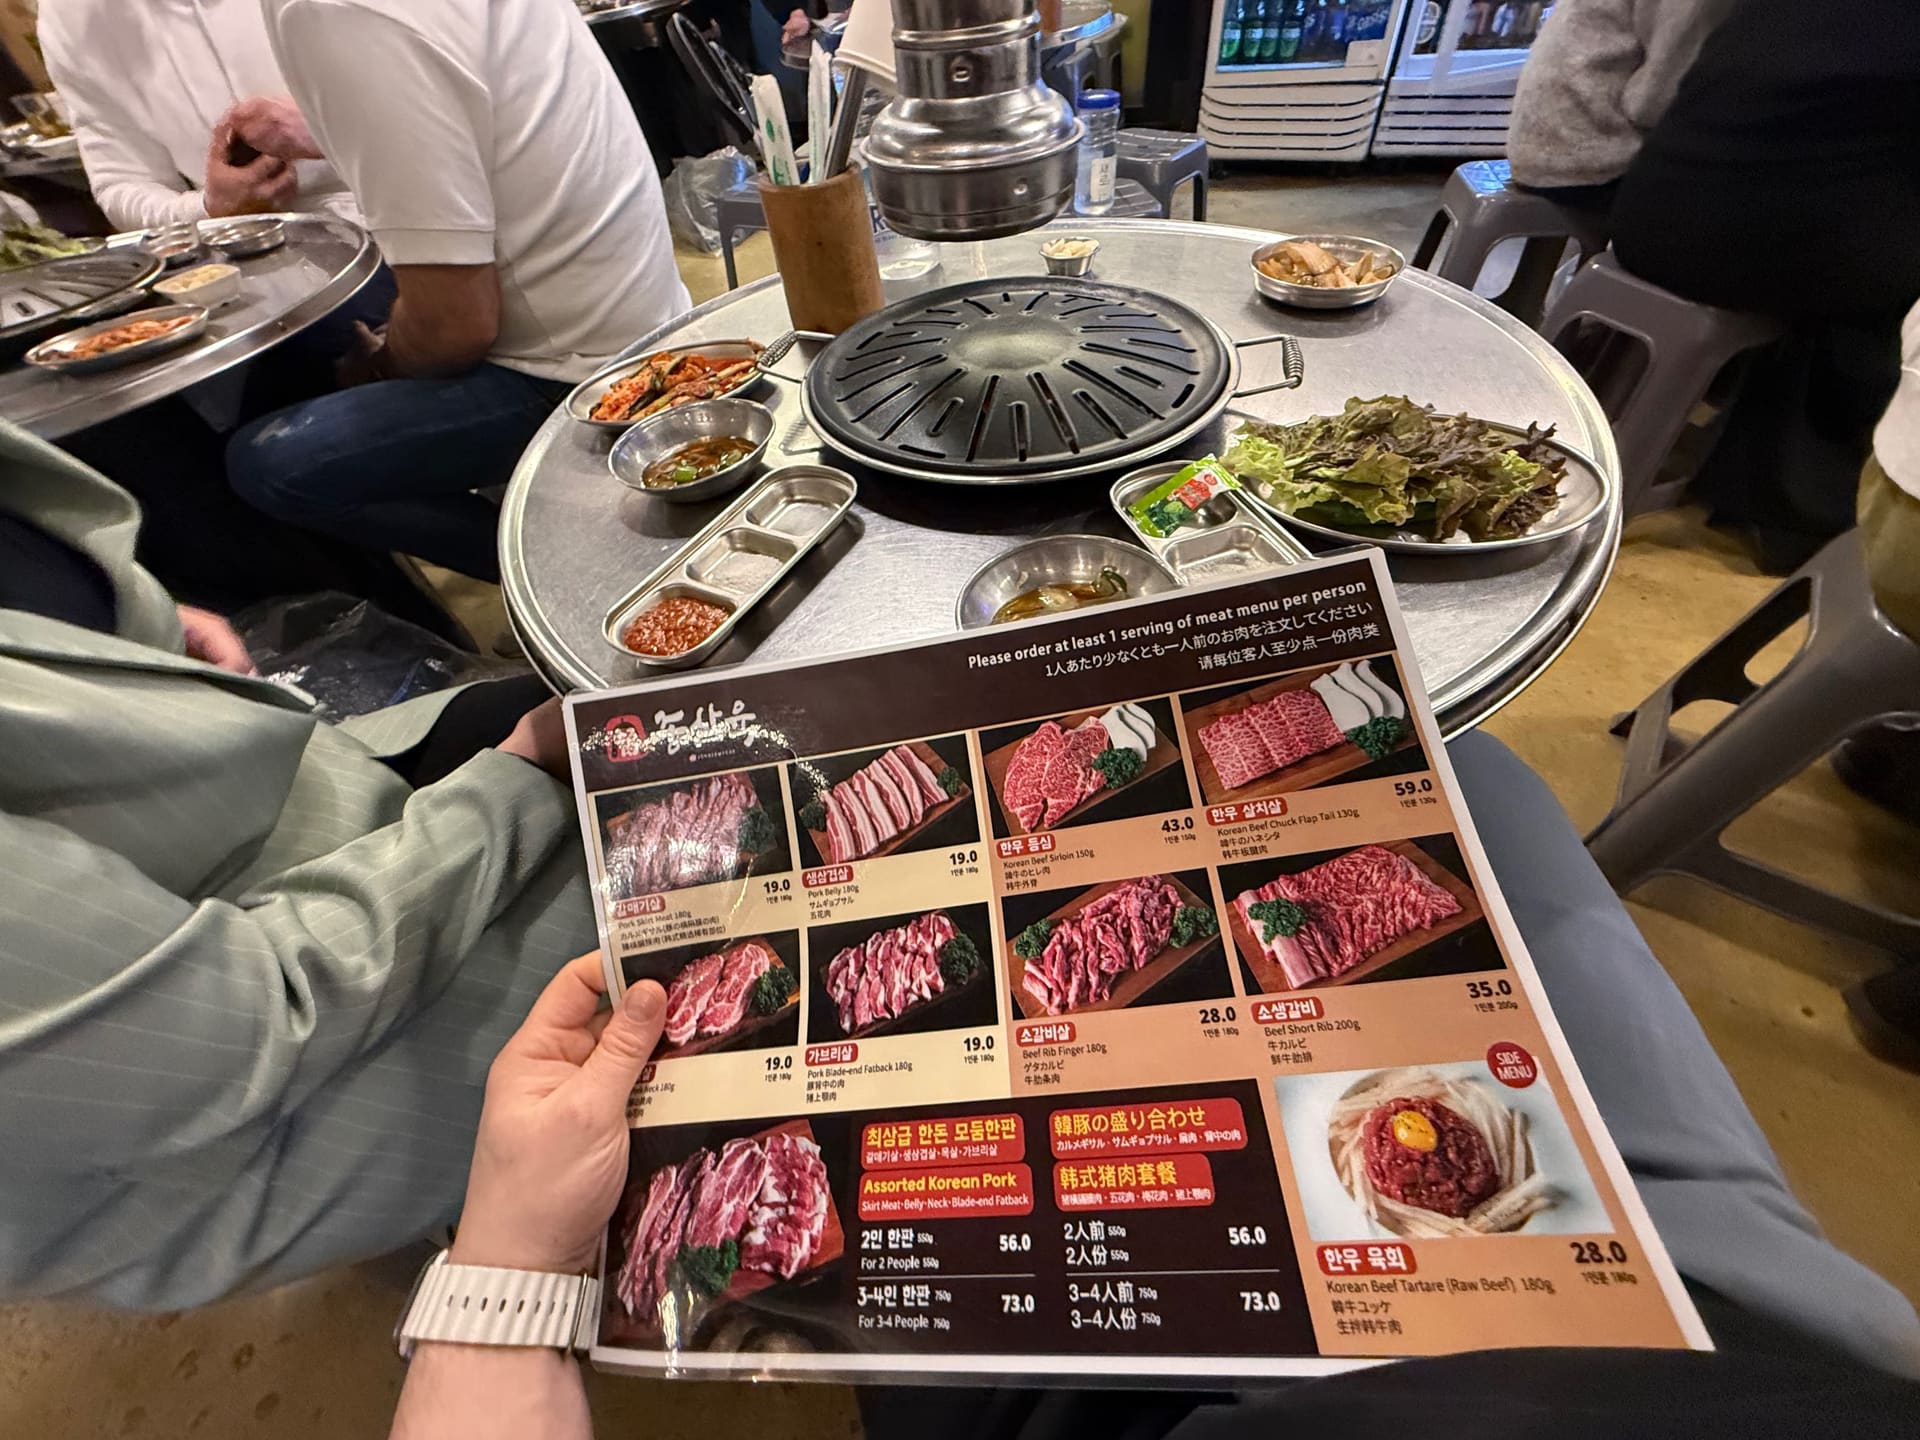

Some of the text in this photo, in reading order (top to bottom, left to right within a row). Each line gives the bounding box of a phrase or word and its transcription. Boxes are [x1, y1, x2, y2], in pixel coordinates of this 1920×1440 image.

[969, 582, 1366, 669] Please order at least 1 serving of meat menu per person
[1045, 602, 1373, 677] 1人あたり少なくとも一人前のお肉を注文してください
[1198, 623, 1380, 671] 请每位客人至少点一份肉类
[1394, 779, 1433, 795] 59.0
[1211, 800, 1282, 822] 한우 살치살
[1161, 817, 1194, 832] 43.0
[1217, 809, 1359, 837] Korean Beef Chuck Flap Tail 130g
[1000, 836, 1052, 856] 한우 등심
[949, 851, 977, 865] 19.0
[1004, 849, 1094, 869] Korean Beef Sirloin 150g
[806, 867, 849, 886] 생삼겹살
[764, 880, 791, 893] 19.0
[808, 885, 859, 898] Pork Belly 180g
[655, 914, 673, 923] Meat
[1467, 980, 1511, 998] 35.0
[1200, 1007, 1236, 1024] 28.0
[1258, 1000, 1316, 1021] 소생갈비
[1021, 1024, 1070, 1044] 소갈비살
[1264, 1019, 1360, 1037] Beef Short Rib 200g
[963, 1036, 994, 1051] 19.0
[1023, 1044, 1107, 1059] Beef Rib Finger 180g
[1268, 1038, 1307, 1051] 牛カルビ
[765, 1056, 792, 1070] 19.0
[808, 1046, 853, 1063] 가브리살
[1495, 1051, 1523, 1065] SIDE
[808, 1061, 912, 1078] Pork Blade-end Fatback 180g
[1024, 1060, 1064, 1072] ゲタカルビ
[1496, 1064, 1533, 1080] MENU
[1055, 1106, 1206, 1136] 韓豚の盛り合わせ
[866, 1118, 1016, 1148] 최상급 한돈 모둠한판
[864, 1172, 1016, 1194] Assorted Korean Pork
[1060, 1161, 1178, 1190] 韩式猪肉套餐
[862, 1201, 880, 1212] Skirt
[996, 1194, 1028, 1205] Fatback
[861, 1228, 933, 1249] 2인 한판 550g
[1064, 1221, 1126, 1242] 2人前 550g
[1228, 1226, 1266, 1245] 56.0
[1000, 1234, 1031, 1251] 56.0
[1066, 1245, 1129, 1266] 2人份 550g
[1324, 1246, 1406, 1272] 한우 육회
[1570, 1241, 1627, 1264] 28.0
[861, 1255, 939, 1271] For 2 People 550g
[1138, 1288, 1158, 1300] 750g
[1327, 1276, 1555, 1295] Korean Beef Tartare (Raw Beef) 180g
[857, 1284, 952, 1307] 3-4인 한판 750g
[1002, 1294, 1035, 1312] 73.0
[1240, 1292, 1281, 1312] 73.0
[859, 1314, 950, 1331] For 3-4 People 750g
[1141, 1313, 1161, 1326] 750g
